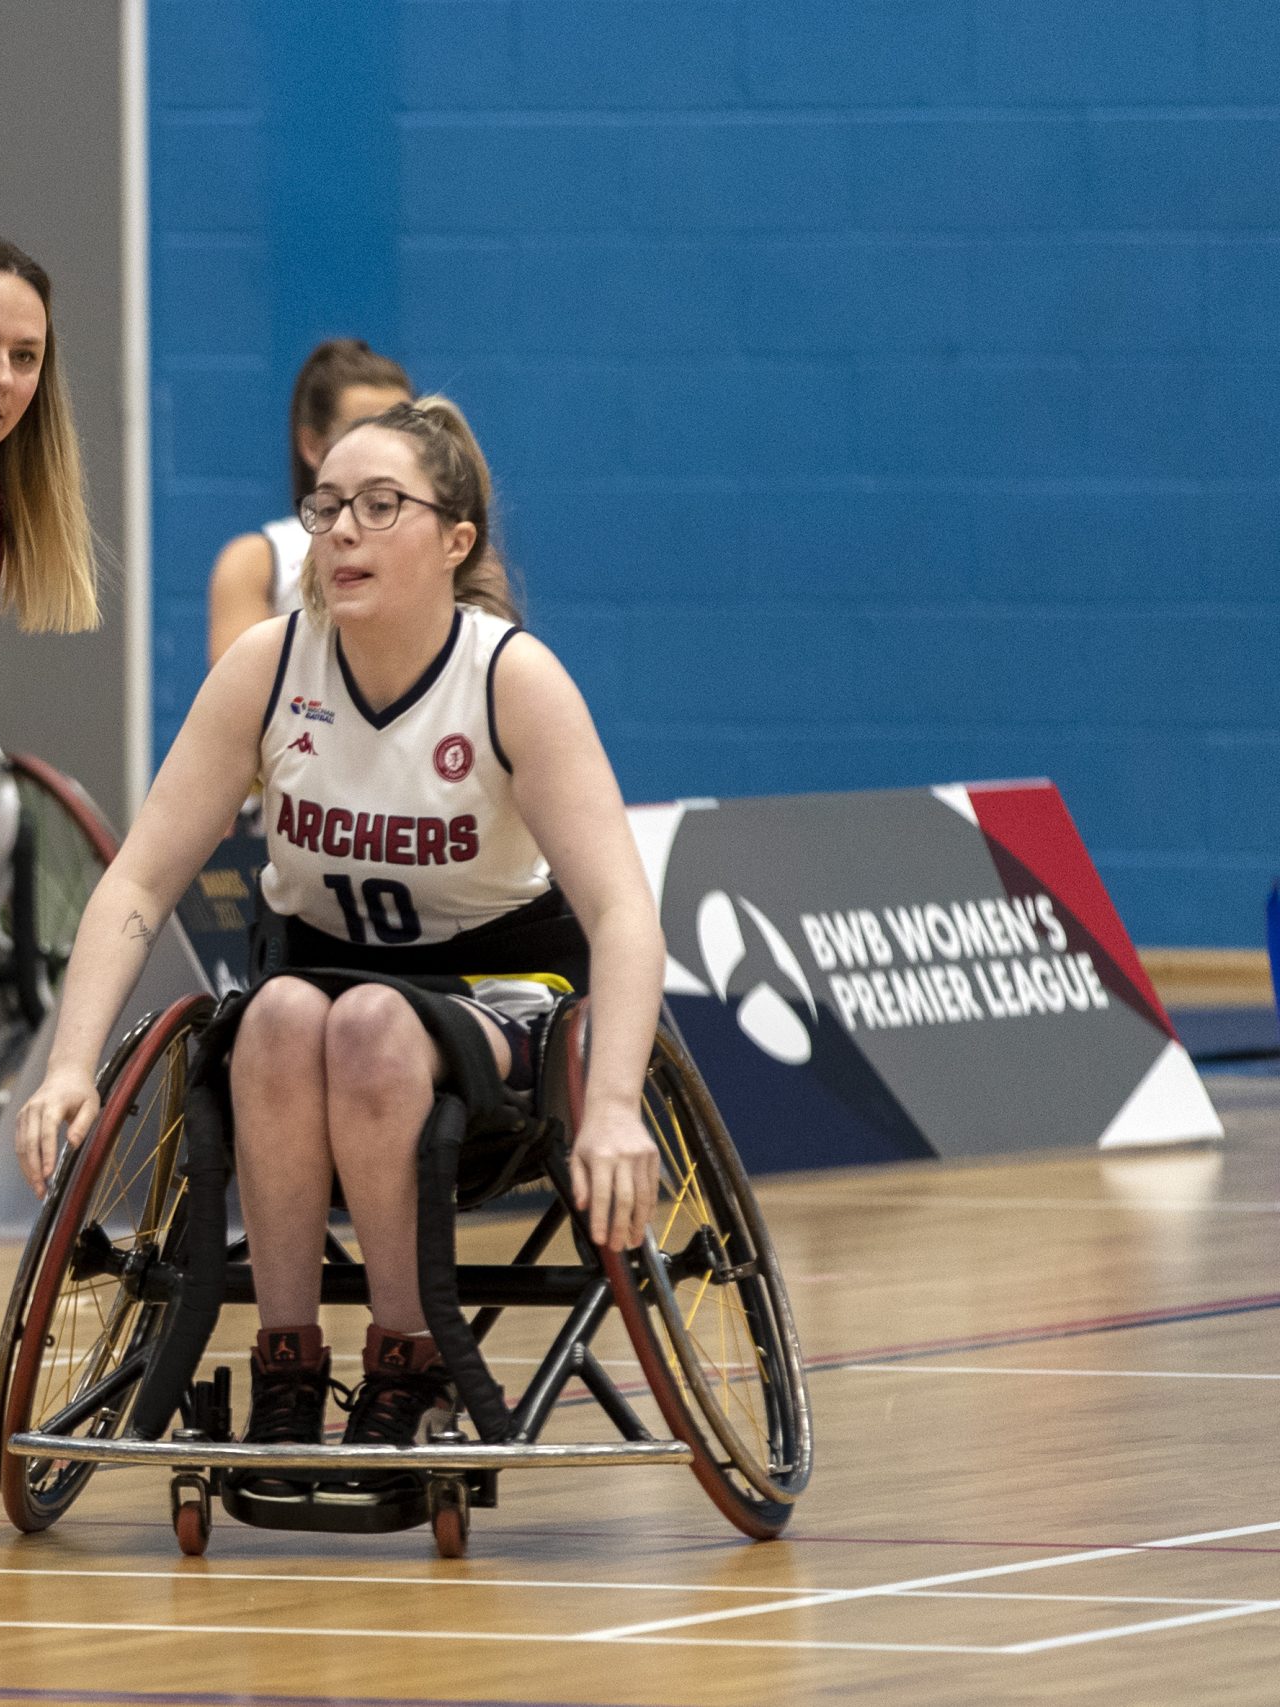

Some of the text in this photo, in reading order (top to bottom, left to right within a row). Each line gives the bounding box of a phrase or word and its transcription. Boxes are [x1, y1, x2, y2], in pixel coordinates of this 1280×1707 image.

[276, 791, 480, 866] ARCHERS
[323, 873, 422, 944] 10
[799, 893, 1068, 971] BWB WOMEN'S
[828, 951, 1110, 1032] PREMIER LEAGUE
